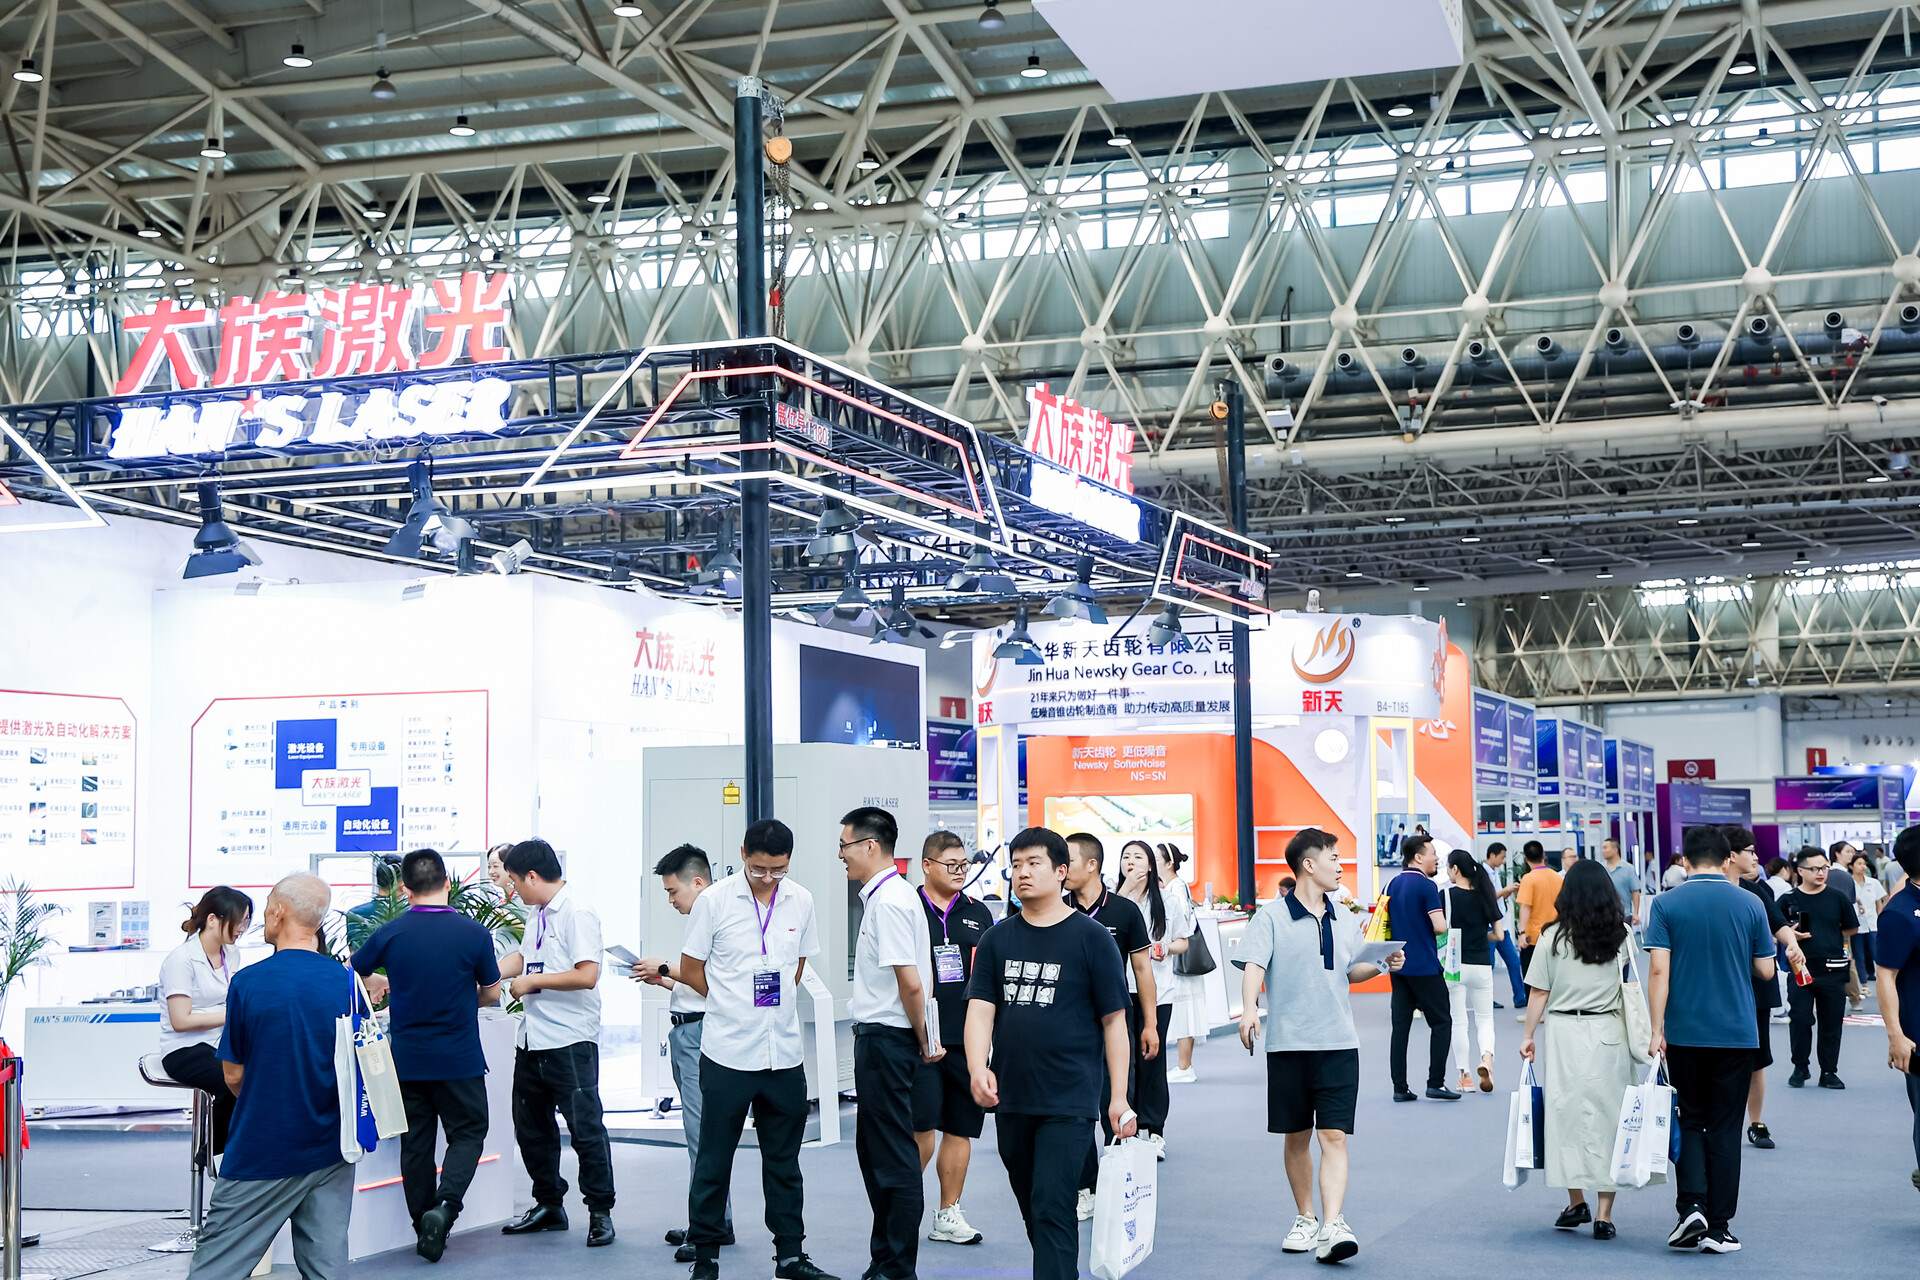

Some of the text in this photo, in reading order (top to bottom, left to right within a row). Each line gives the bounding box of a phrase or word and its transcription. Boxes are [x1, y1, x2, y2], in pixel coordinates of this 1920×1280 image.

[115, 271, 512, 396] 大族激光
[308, 377, 512, 444] LASER
[1024, 382, 1135, 496] 大族激光
[1029, 634, 1234, 660] 华新天齿轮有限公司
[1027, 668, 1043, 682] Jin
[1046, 667, 1070, 681] Hua
[1074, 665, 1127, 680] Newsky
[1132, 662, 1168, 676] Gear
[1124, 701, 1231, 715] 助力传动高质量发展
[1302, 690, 1343, 712] 新天
[1377, 701, 1409, 713] B4-T185
[312, 776, 361, 789] 大族激光
[1130, 772, 1166, 780] NS=SN
[63, 1015, 90, 1023] MOTOR
